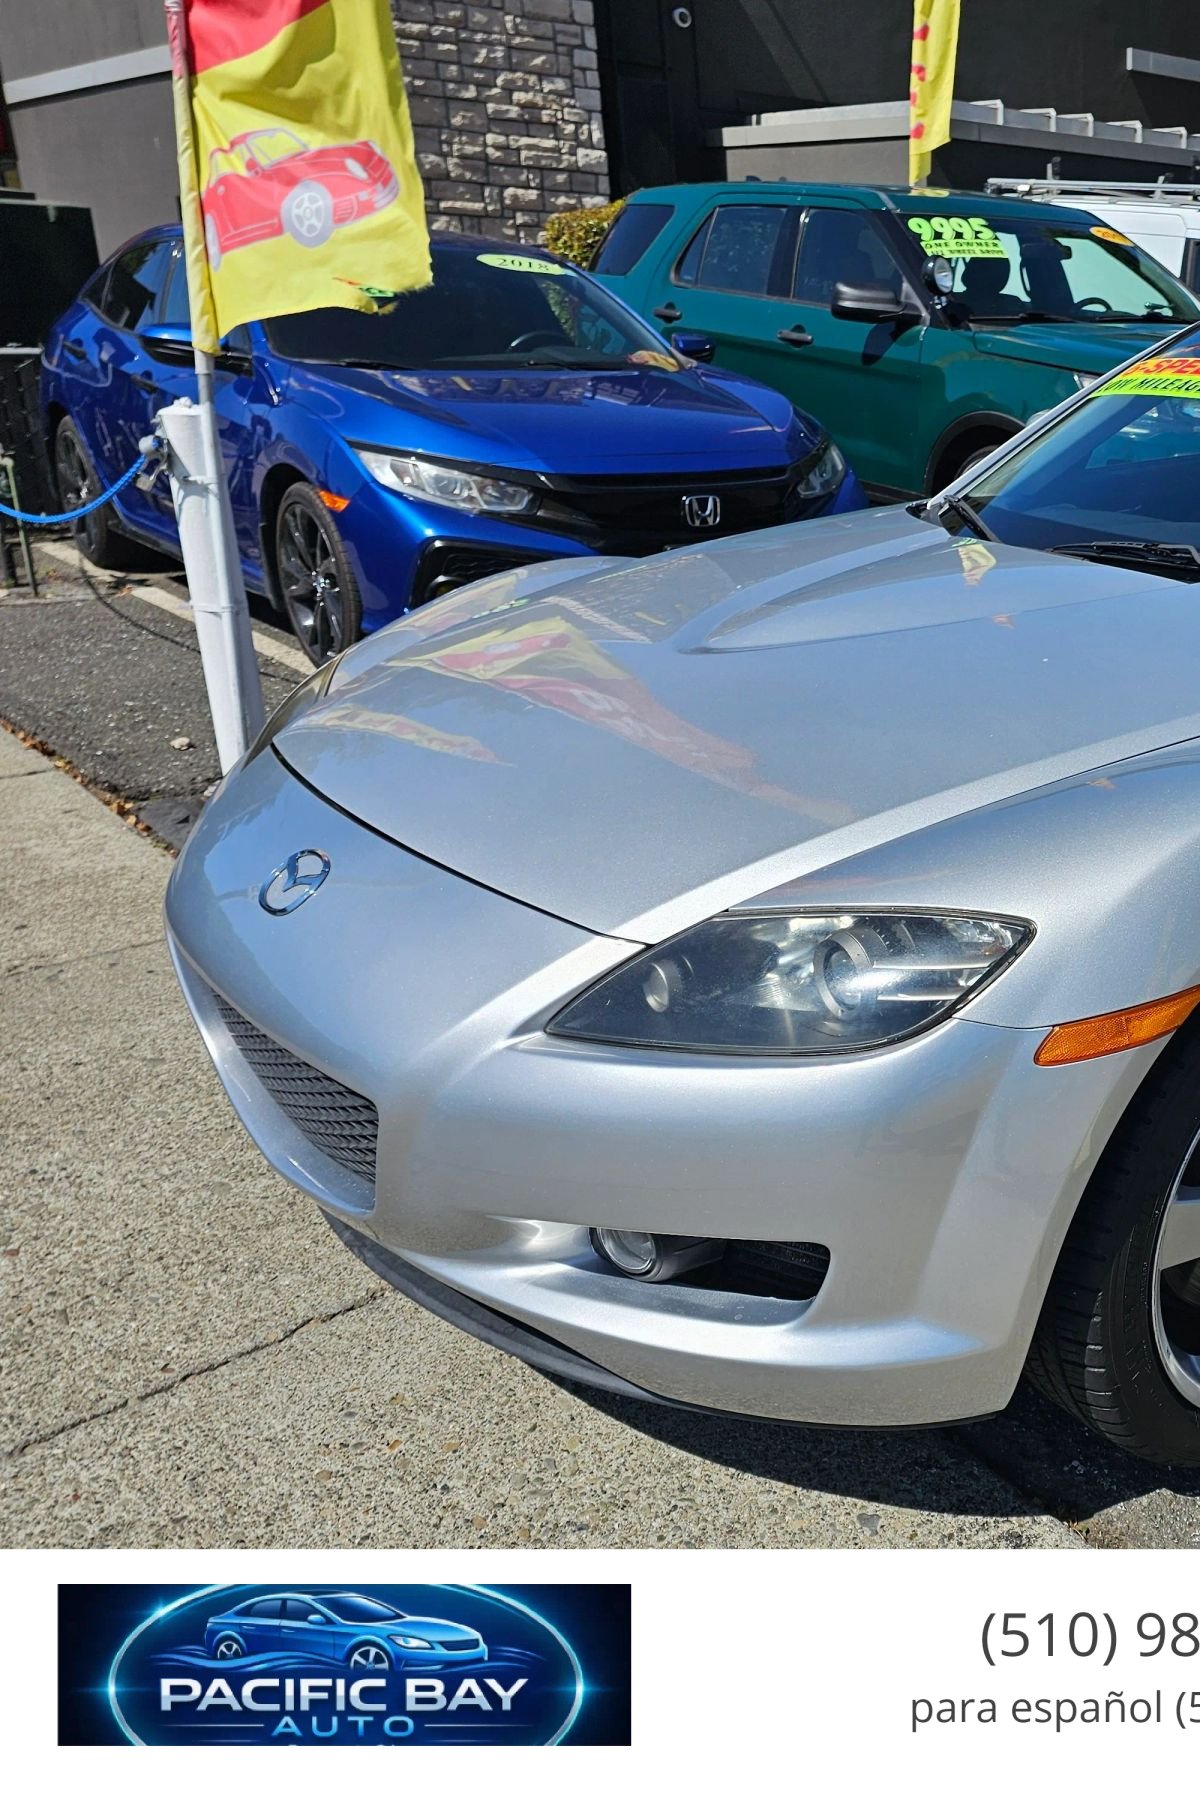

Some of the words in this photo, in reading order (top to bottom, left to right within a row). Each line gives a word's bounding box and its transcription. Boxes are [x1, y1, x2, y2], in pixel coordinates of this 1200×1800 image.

[907, 216, 995, 241] 9995
[924, 241, 950, 250] ONE
[955, 241, 1000, 249] OWNER
[497, 257, 549, 271] 2018
